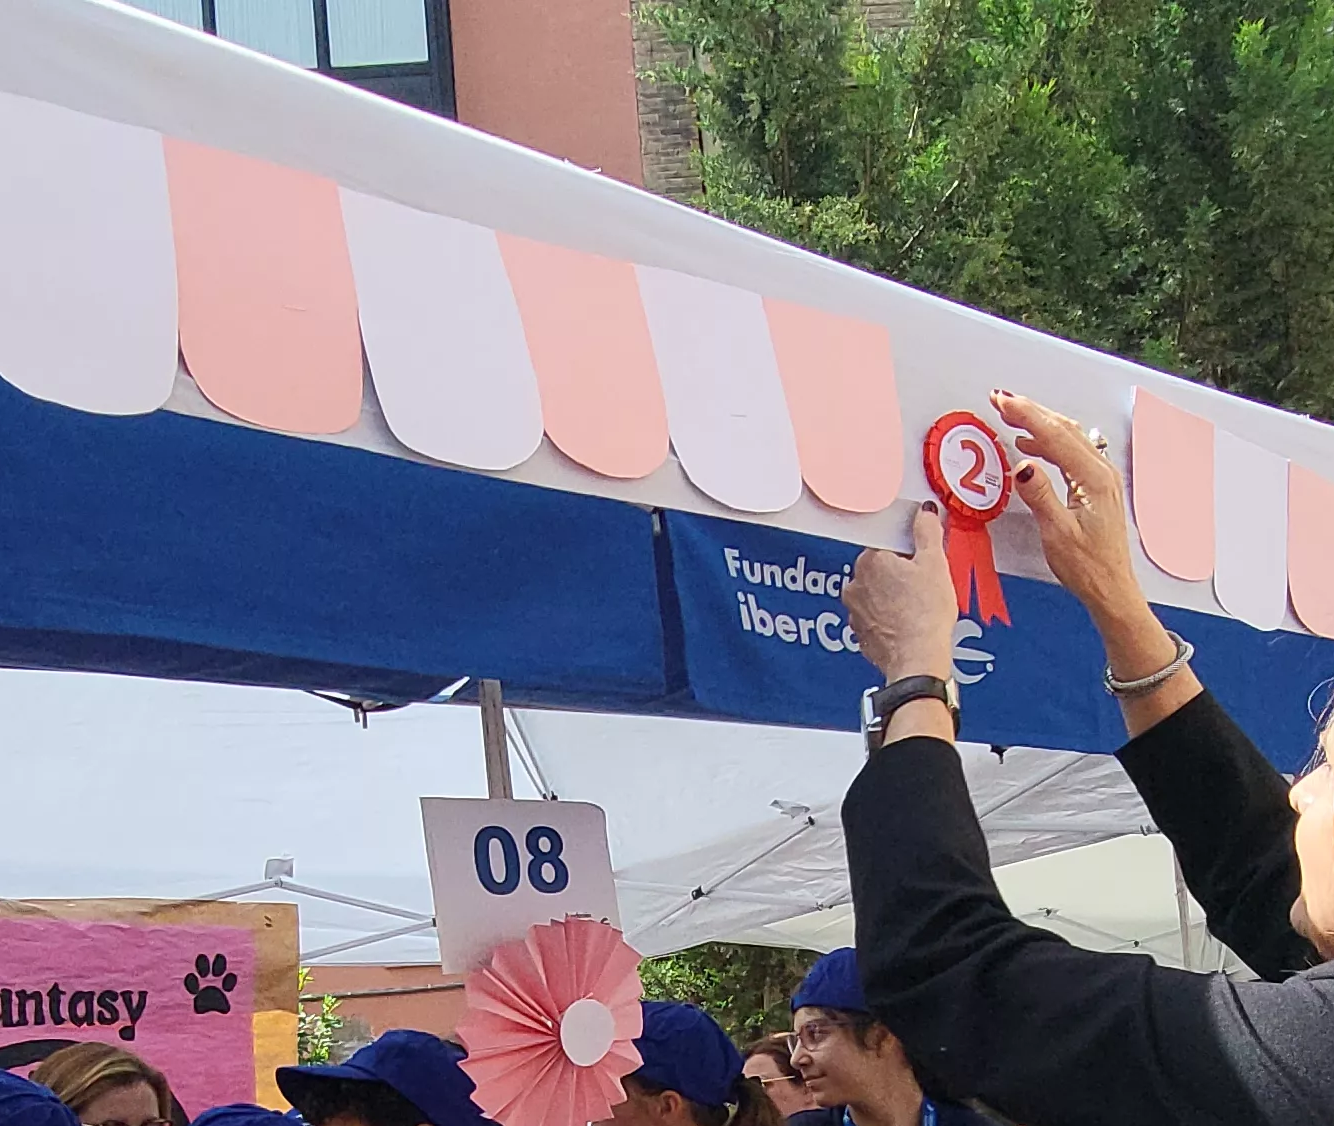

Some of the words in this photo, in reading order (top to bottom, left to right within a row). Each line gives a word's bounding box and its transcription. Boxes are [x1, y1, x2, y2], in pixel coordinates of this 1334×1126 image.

[959, 439, 987, 497] 2
[724, 547, 851, 598] Fundaci
[473, 825, 569, 896] 08
